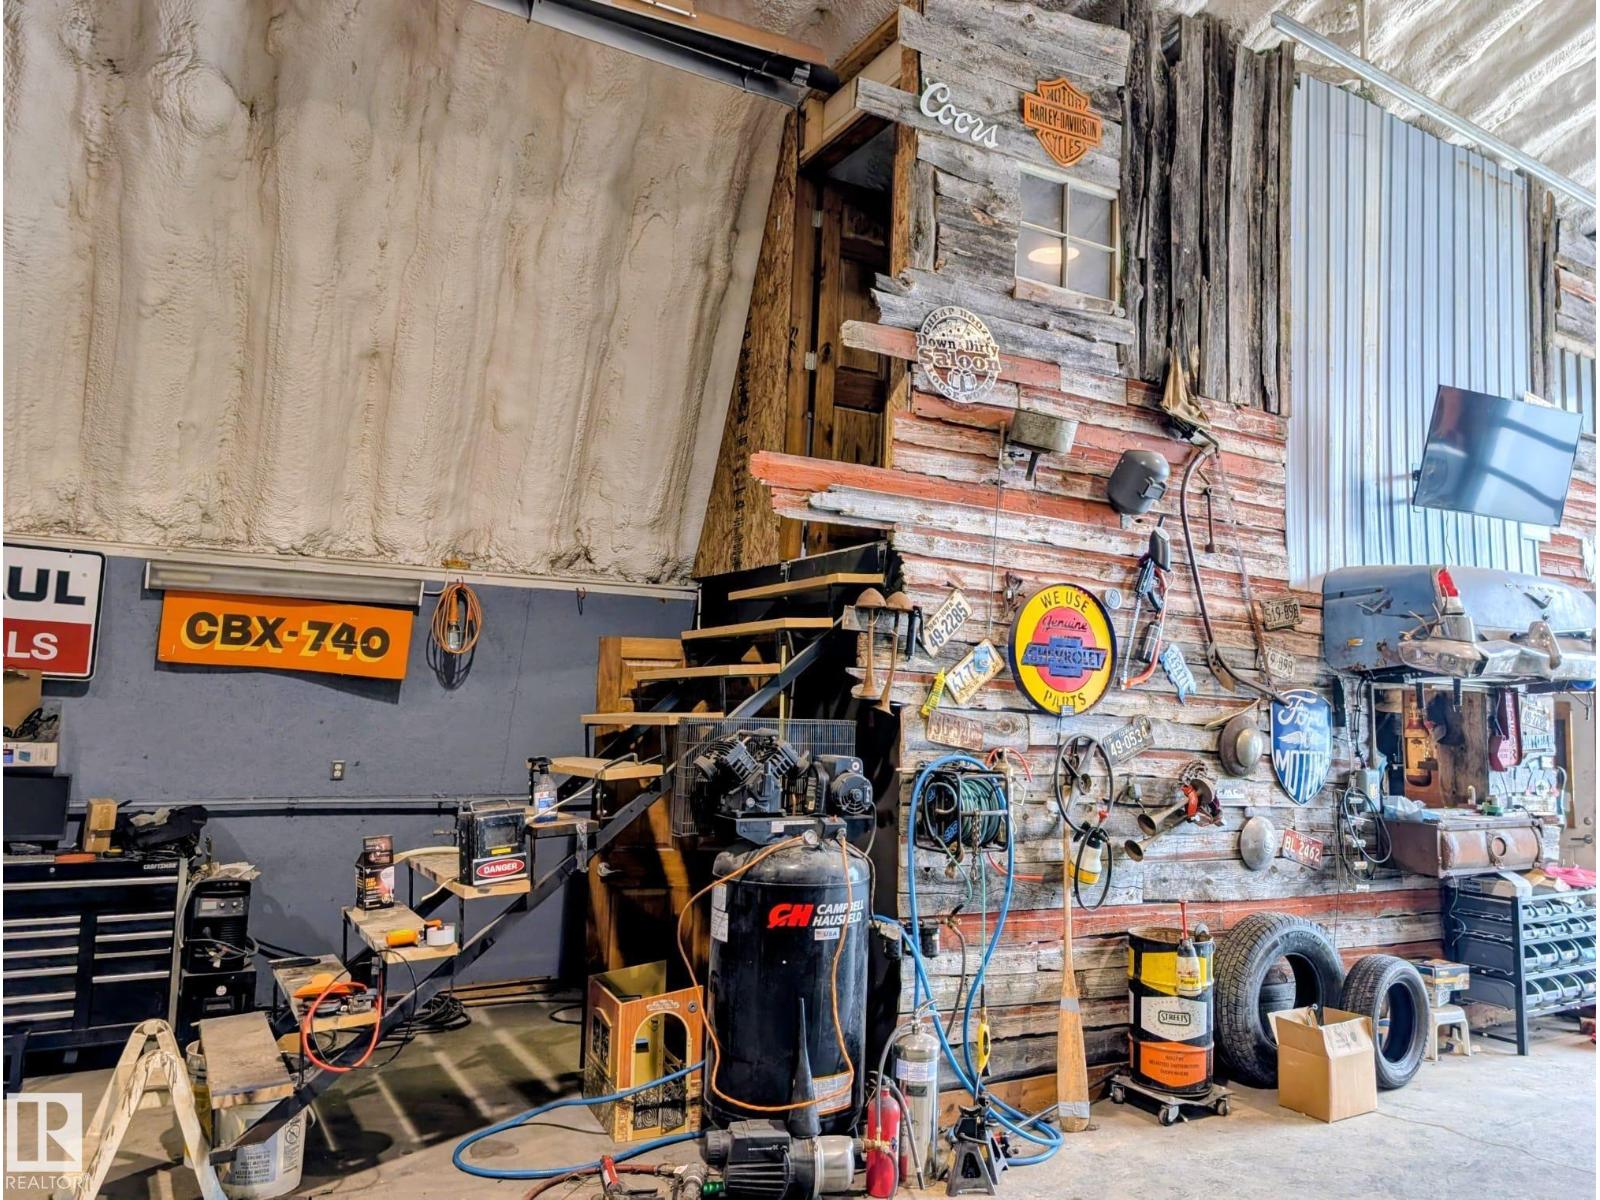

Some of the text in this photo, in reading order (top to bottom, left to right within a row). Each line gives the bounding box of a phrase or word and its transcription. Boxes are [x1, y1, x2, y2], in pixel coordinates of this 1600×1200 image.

[1046, 86, 1086, 110] MOTOR
[920, 78, 999, 148] Coors
[1029, 103, 1097, 137] HARLEY-DAVIDSON
[1045, 133, 1081, 159] CYCLES
[917, 335, 956, 350] Down
[918, 347, 1001, 372] Saloon
[3, 565, 86, 606] UL
[1041, 591, 1089, 613] WE USE
[1042, 615, 1088, 632] Genuine
[3, 631, 58, 660] LS
[182, 612, 391, 662] CBX-740
[1026, 646, 1101, 667] CHEVROLET
[1043, 690, 1087, 706] PARTS
[1284, 835, 1296, 853] BL
[483, 860, 518, 875] DANGER
[1160, 1012, 1188, 1024] STREETS
